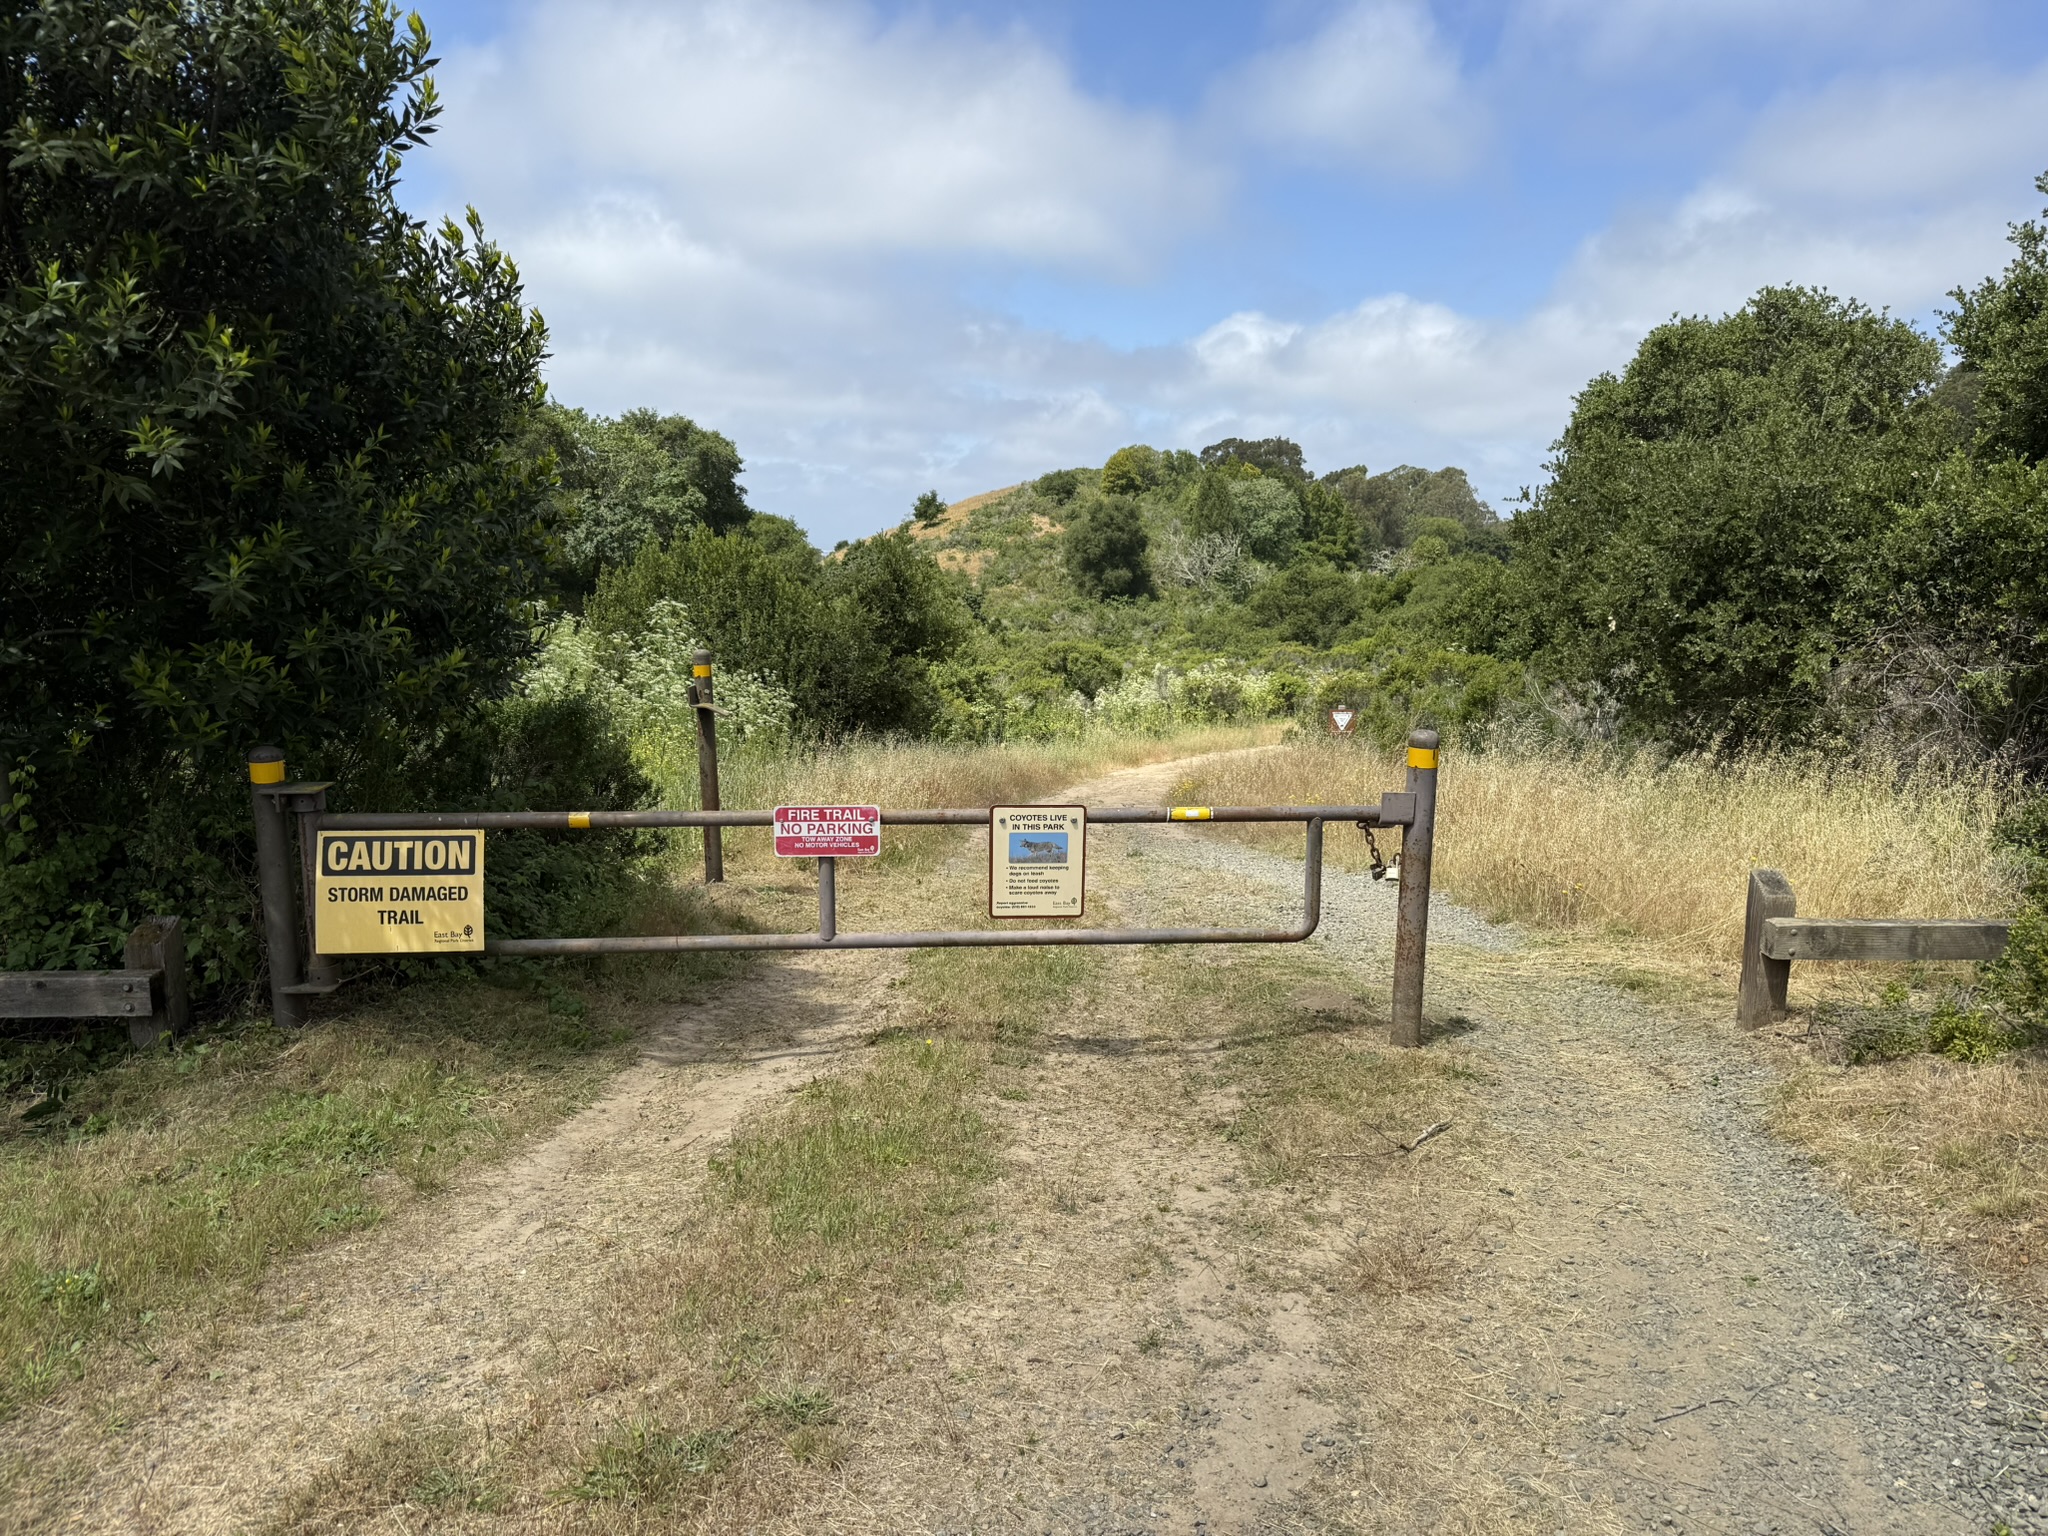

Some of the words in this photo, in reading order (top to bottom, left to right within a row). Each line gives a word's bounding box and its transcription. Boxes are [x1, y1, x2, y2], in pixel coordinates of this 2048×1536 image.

[788, 809, 820, 821] FIRE
[823, 809, 865, 821] TRAIL
[1009, 814, 1048, 822] COYOTES
[1050, 814, 1068, 822] LIVE
[780, 823, 802, 835] NO
[807, 823, 873, 835] PARKING
[1012, 823, 1020, 831] IN
[1023, 823, 1041, 831] THIS
[1043, 823, 1065, 831] PARK
[327, 840, 471, 871] CAUTION
[328, 887, 383, 902] STORM
[389, 886, 469, 902] DAMAGED
[377, 910, 424, 925] TRAIL
[450, 931, 462, 939] Bay
